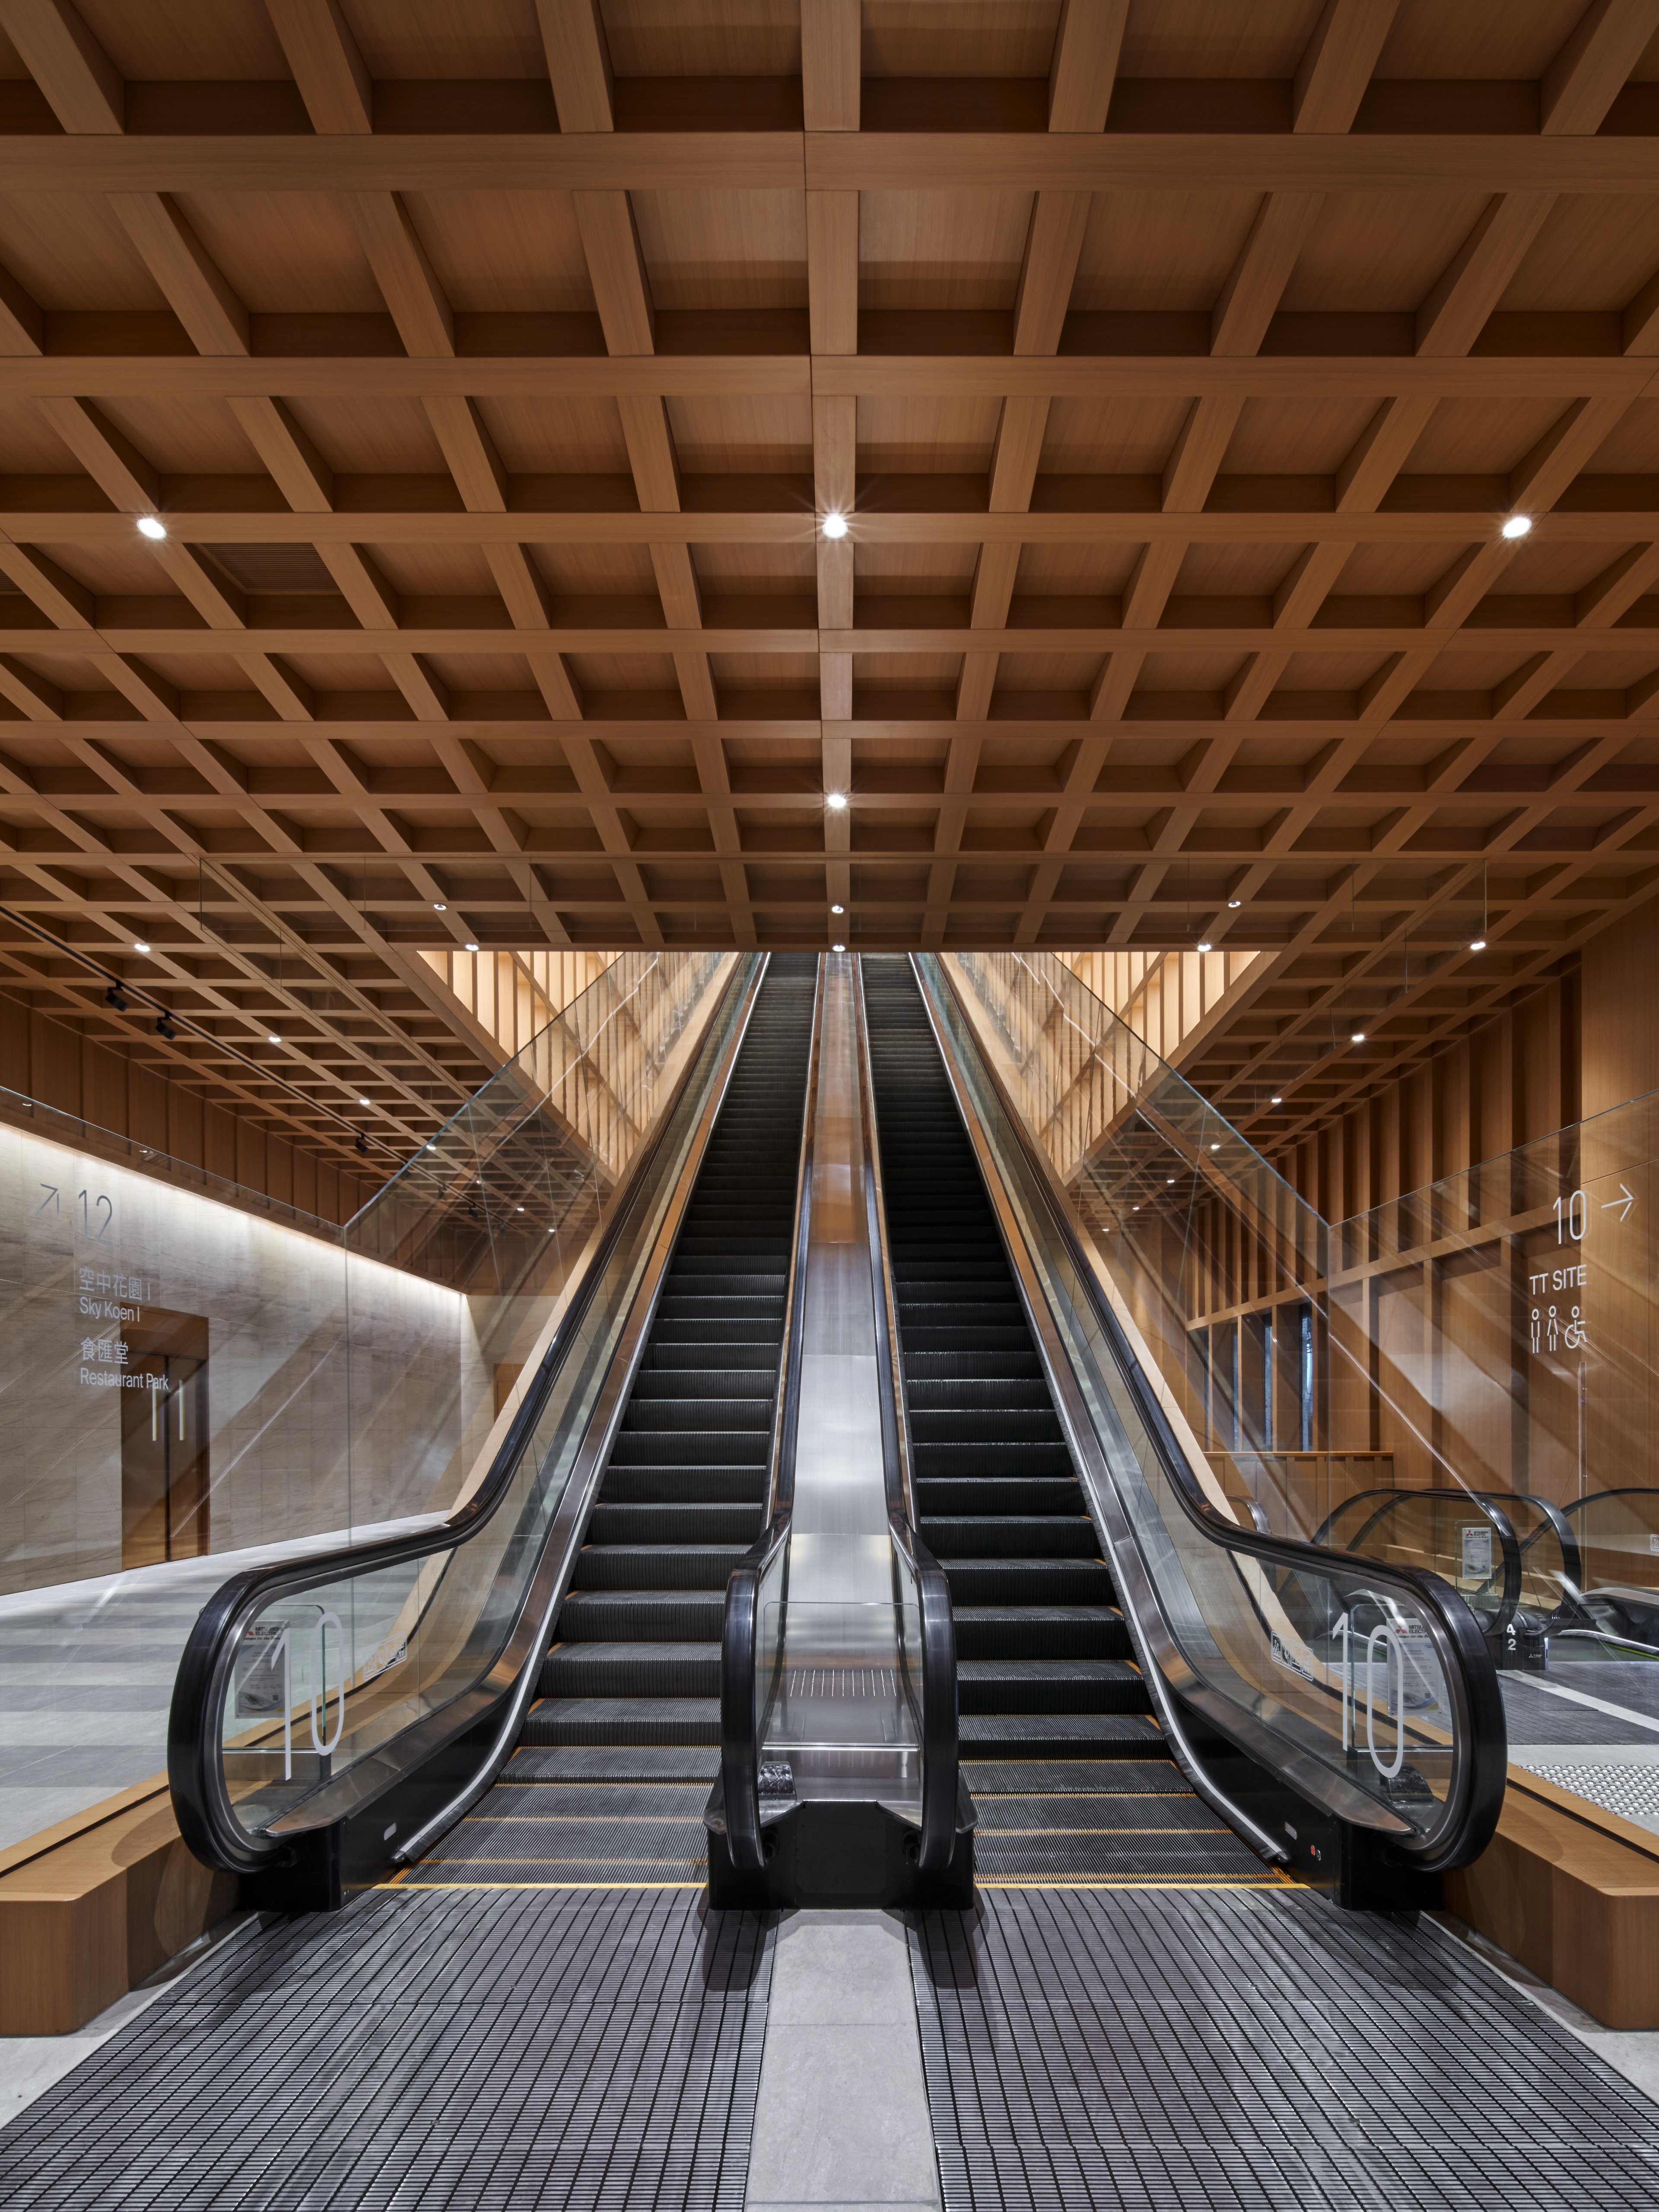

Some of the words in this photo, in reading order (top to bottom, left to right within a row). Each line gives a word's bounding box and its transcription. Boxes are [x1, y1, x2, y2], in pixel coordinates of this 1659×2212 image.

[79, 1189, 113, 1245] 12
[1553, 1190, 1586, 1244] 10
[79, 1266, 142, 1301] 空中花園
[1529, 1273, 1548, 1295] TT
[1553, 1264, 1586, 1290] SITE
[80, 1297, 102, 1319] Sky
[105, 1301, 134, 1321] Koen
[137, 1306, 140, 1322] I
[80, 1337, 128, 1364] 食匯堂
[80, 1367, 143, 1388] Restaurant
[146, 1373, 169, 1390] Park
[1506, 1624, 1516, 1635] 4
[1508, 1639, 1516, 1650] 2
[271, 1612, 344, 1780] 10
[1333, 1612, 1403, 1778] 10
